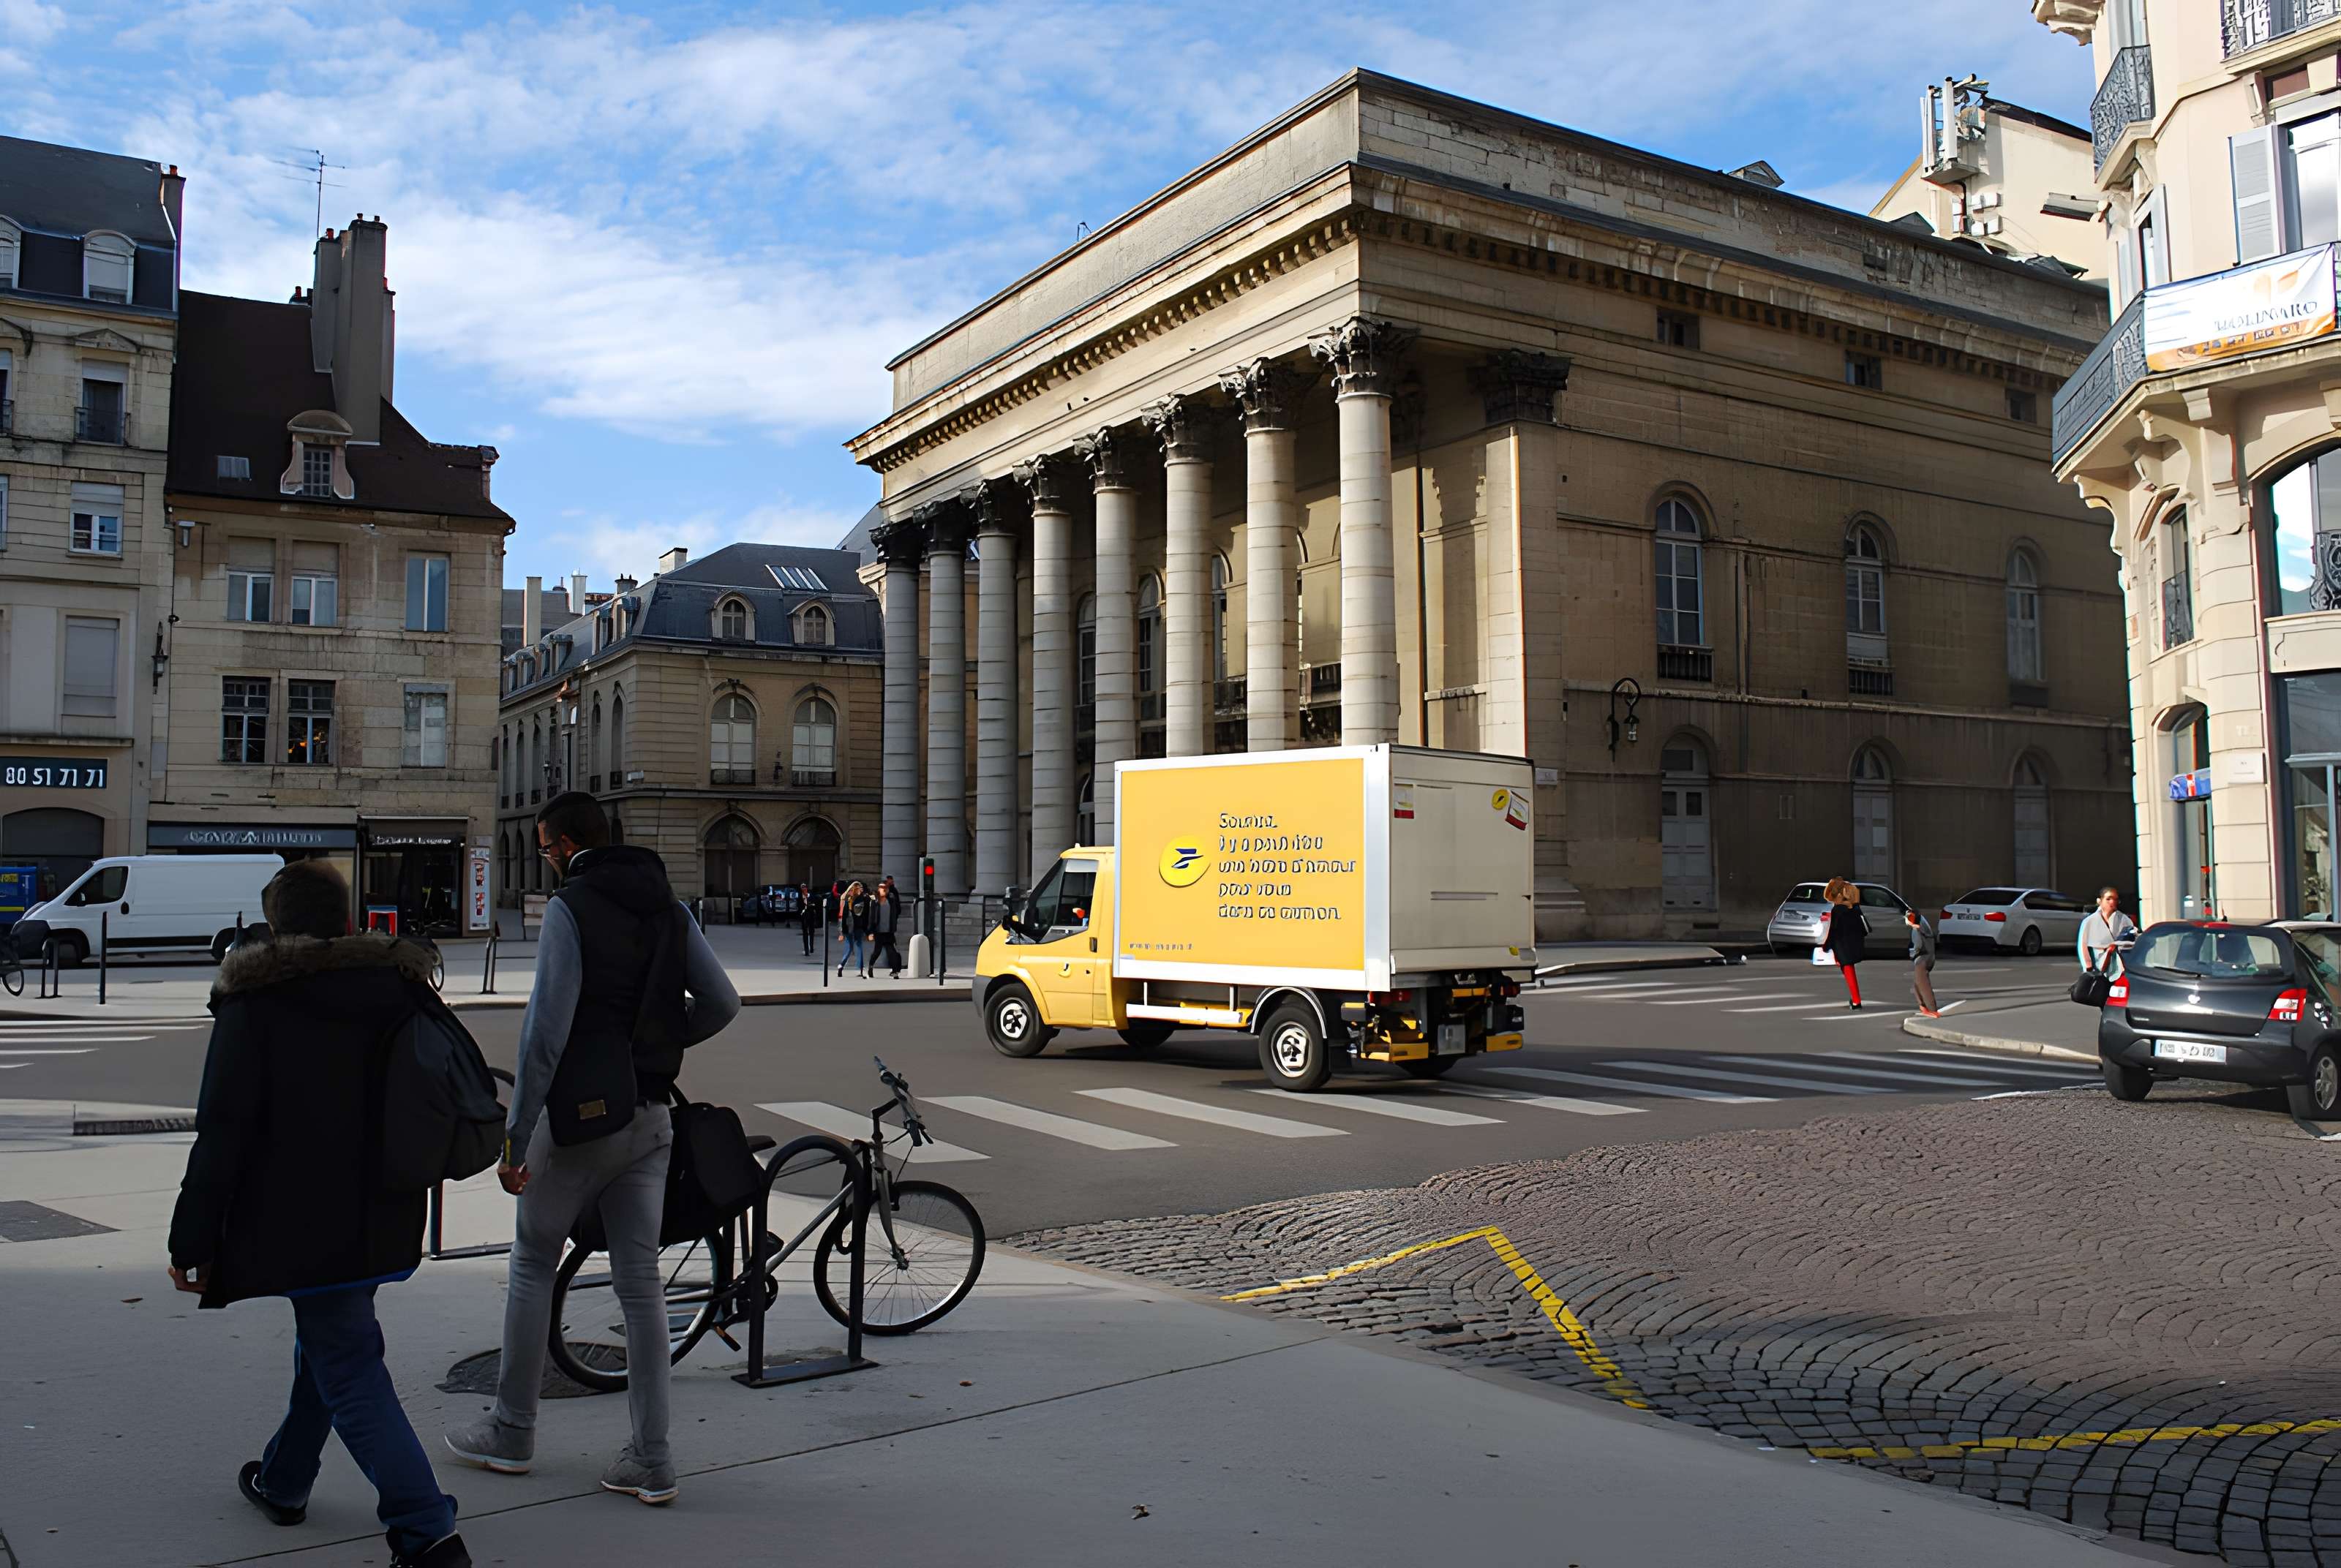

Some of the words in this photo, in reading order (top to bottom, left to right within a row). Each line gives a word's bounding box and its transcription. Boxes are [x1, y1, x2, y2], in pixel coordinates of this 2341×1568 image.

[6, 766, 26, 785] 80
[32, 767, 51, 786] 51
[59, 768, 78, 787] 71
[85, 769, 103, 788] 71
